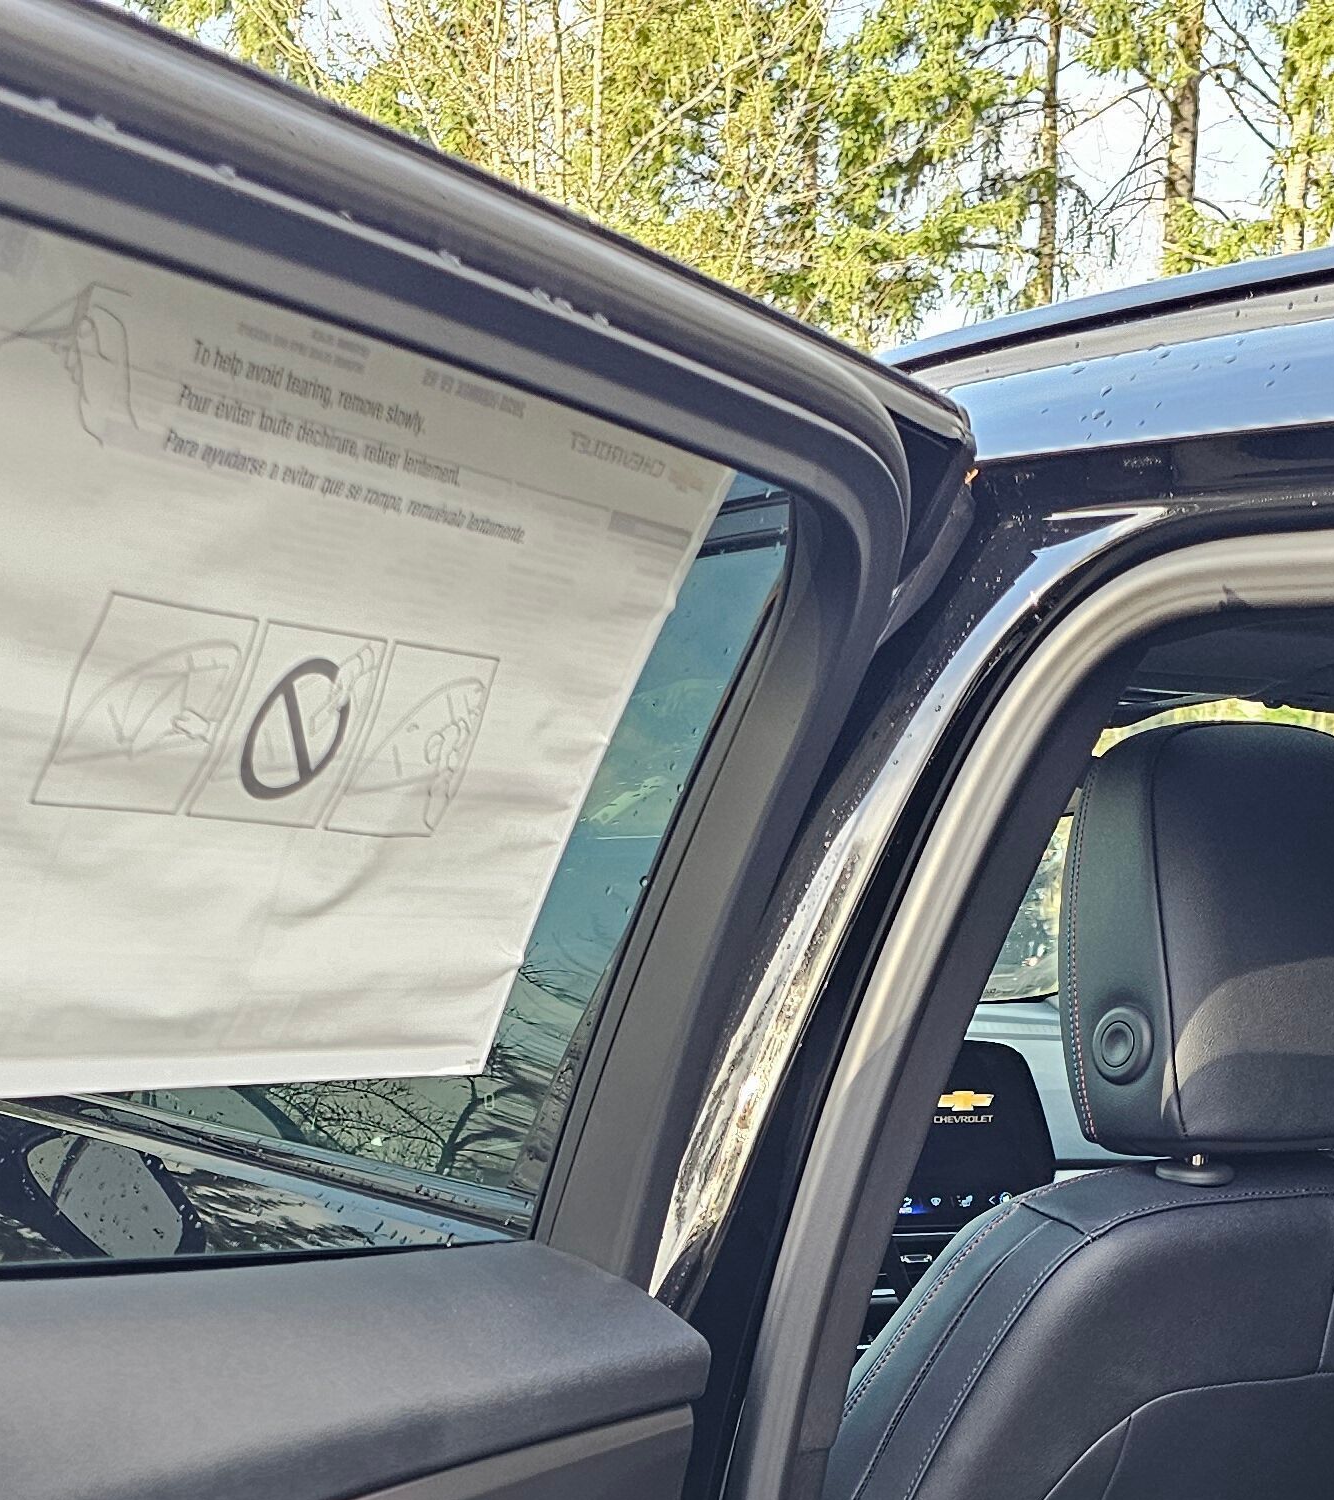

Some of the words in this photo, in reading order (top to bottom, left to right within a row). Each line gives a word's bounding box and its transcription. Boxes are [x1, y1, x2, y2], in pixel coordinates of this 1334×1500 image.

[194, 338, 211, 367] To
[213, 346, 244, 381] help
[246, 361, 285, 390] avoid
[285, 369, 333, 410] tearing,
[338, 390, 384, 421] remove
[178, 383, 212, 413] Pour
[259, 410, 294, 440] toute
[164, 428, 199, 459] Para
[933, 1114, 994, 1124] CHEVROLET
